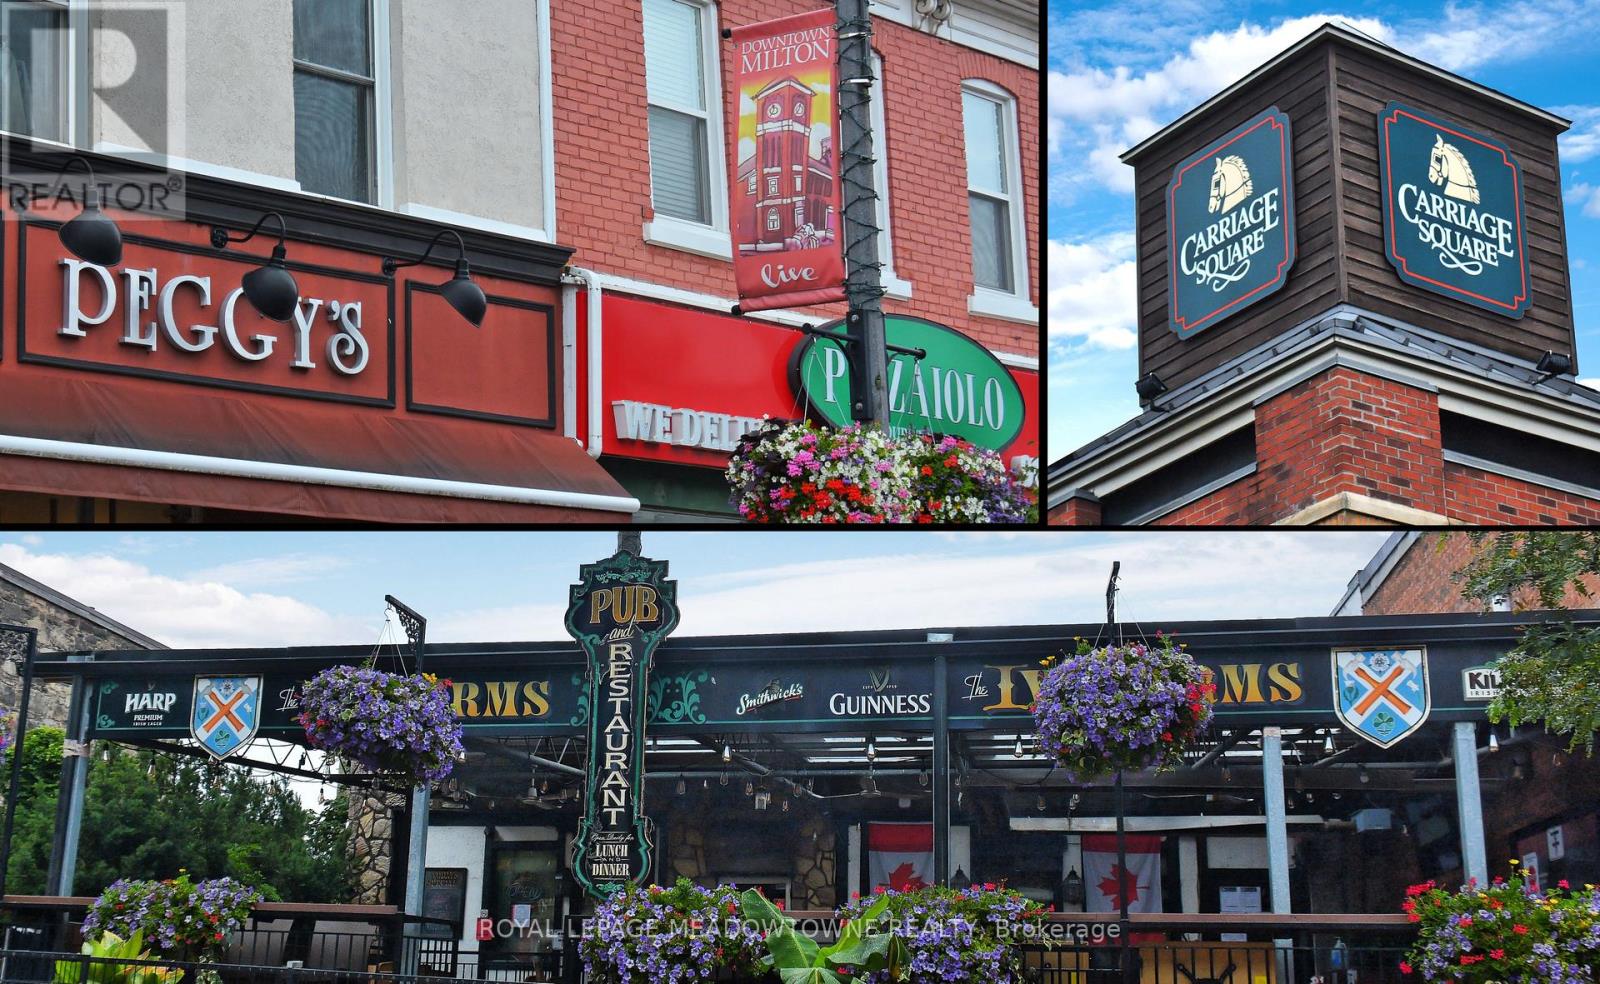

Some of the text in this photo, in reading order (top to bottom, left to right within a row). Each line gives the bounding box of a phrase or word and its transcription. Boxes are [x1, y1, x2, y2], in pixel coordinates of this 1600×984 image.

[741, 39, 830, 74] MILTON
[742, 26, 830, 54] DOWNTOWN
[1180, 187, 1279, 275] CARRIAGE
[1398, 183, 1514, 257] CARRIAGE
[1196, 227, 1265, 292] SQUARE
[1418, 219, 1498, 275] SQUARE
[57, 257, 369, 375] PEGGY'S
[824, 346, 1004, 431] PZAIOLO
[612, 400, 673, 443] WE
[590, 585, 659, 624] PUB
[608, 616, 635, 640] and
[125, 693, 177, 713] HARP
[452, 681, 550, 717] RMS
[736, 682, 804, 715] Smithwick's
[829, 692, 932, 715] GUINNESS
[961, 671, 989, 701] The
[602, 643, 633, 826] RESTAURANT
[596, 844, 629, 857] LUNCH
[592, 863, 630, 876] DINNER
